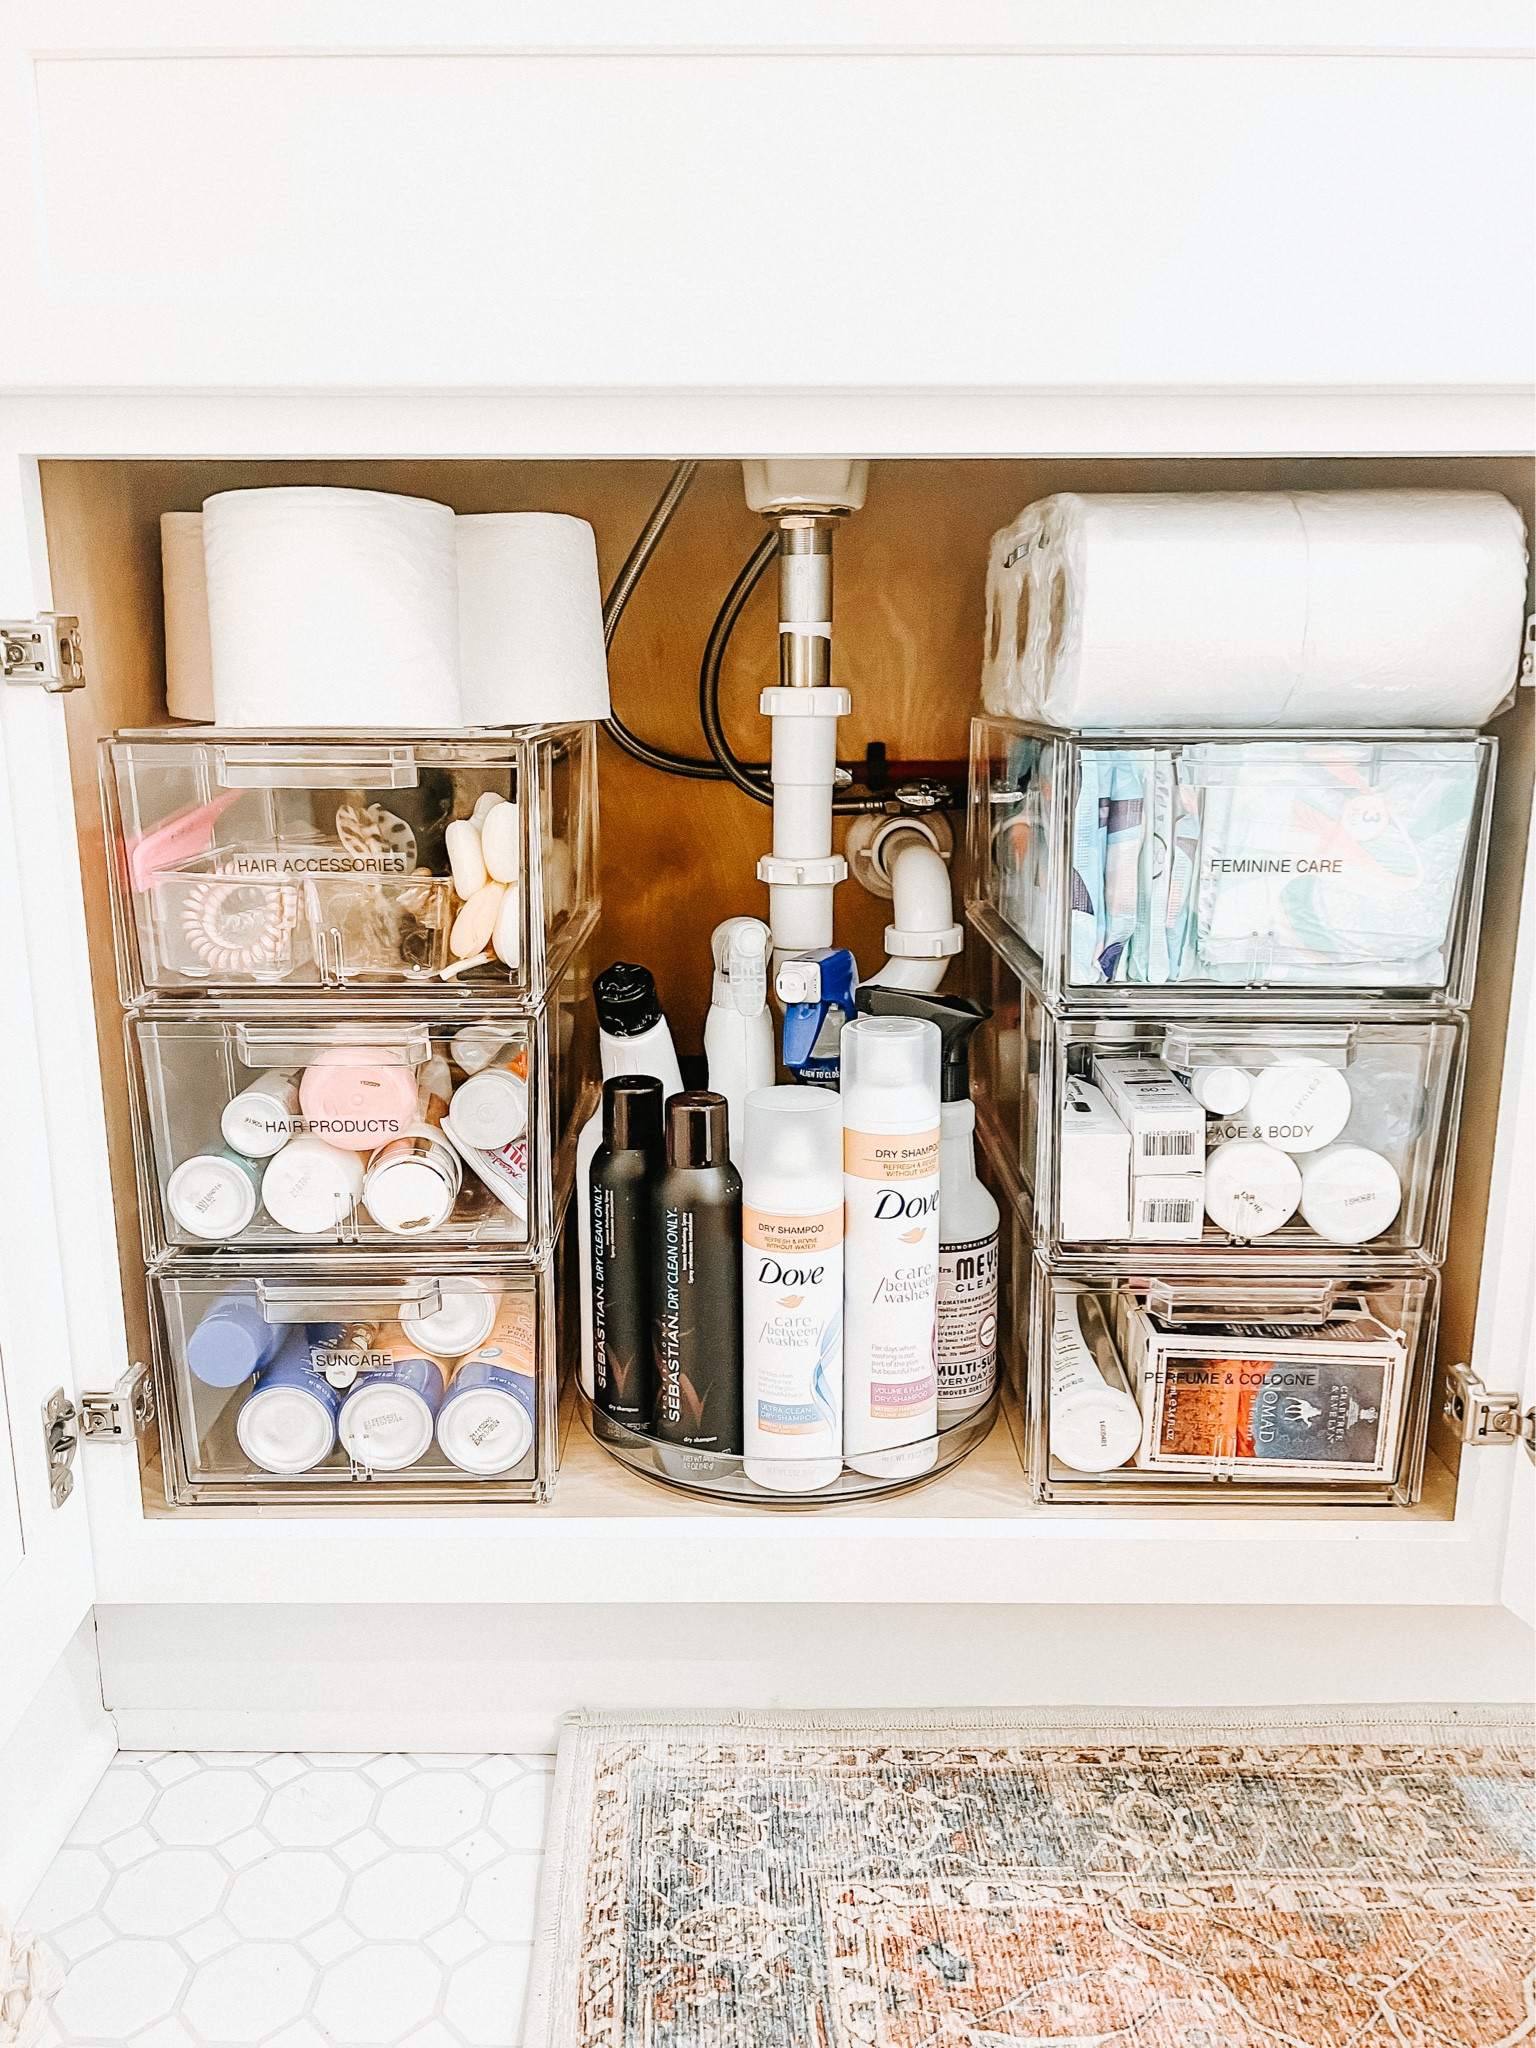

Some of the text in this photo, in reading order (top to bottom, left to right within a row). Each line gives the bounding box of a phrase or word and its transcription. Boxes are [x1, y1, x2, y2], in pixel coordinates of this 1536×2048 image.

[238, 858, 405, 872] HAIR ACCESSORIES
[1211, 859, 1343, 873] FEMININE CARE
[800, 1069, 815, 1078] ALIGN
[265, 1120, 303, 1132] HAIR
[309, 1119, 399, 1132] PRODUCTS
[1206, 1125, 1314, 1138] FACE & BODY
[876, 1149, 898, 1158] DRY
[886, 1169, 918, 1177] WITHOUT
[874, 1189, 940, 1219] Dove
[758, 1223, 824, 1234] DRY SHAMPOO
[764, 1236, 791, 1244] REFRESH
[939, 1240, 988, 1251] ARDWORKING
[758, 1258, 824, 1286] Dove
[894, 1263, 931, 1280] care
[594, 1186, 606, 1389] SEBASTIAN DRY CLEAN ONLY
[886, 1275, 935, 1291] between
[955, 1273, 996, 1293] CLEAN
[884, 1288, 930, 1303] washes
[666, 1210, 680, 1422] SEBASTIAN DRY CLEAN ONLY
[774, 1316, 812, 1327] care
[767, 1323, 818, 1337] between
[766, 1336, 809, 1347] washes
[316, 1354, 392, 1366] SUNCARE
[938, 1351, 996, 1377] MULTI-SU
[1145, 1372, 1315, 1385] PERFUME & COLOGNE
[892, 1391, 928, 1403] SHAMPOO
[938, 1384, 982, 1397] EMOVES DIRT
[760, 1403, 783, 1413] ULTRA
[1259, 1376, 1282, 1443] NOMAD
[1335, 1386, 1348, 1441] CRABTREE
[760, 1411, 818, 1421] DRY SHAMPOO
[1327, 1395, 1339, 1443] EVELYN
